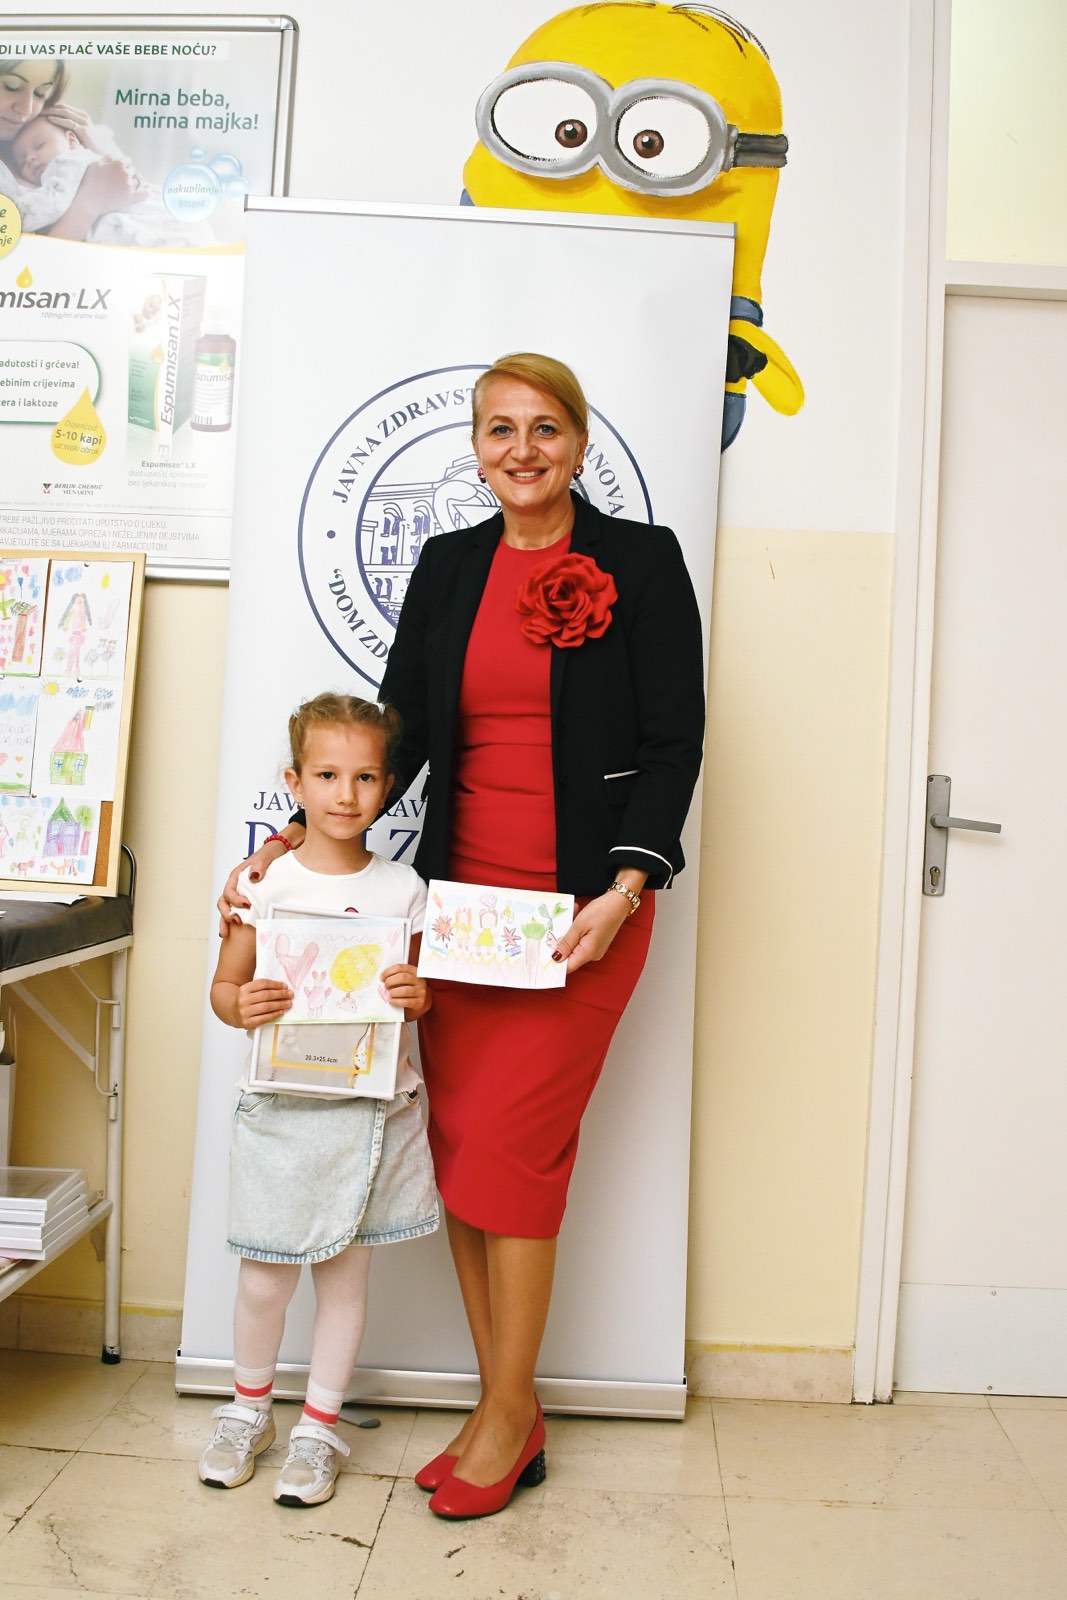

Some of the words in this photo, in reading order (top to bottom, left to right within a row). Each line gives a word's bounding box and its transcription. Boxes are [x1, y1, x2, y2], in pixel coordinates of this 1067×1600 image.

[15, 44, 27, 55] LI
[30, 44, 56, 55] VAS
[59, 41, 94, 55] PLAČ
[96, 41, 131, 55] VAŠE
[134, 44, 168, 56] BEBE
[172, 42, 217, 56] NOĆU?
[115, 89, 171, 106] Mirna
[178, 89, 230, 110] beba,
[134, 112, 189, 130] mirna
[195, 113, 259, 133] majka!
[76, 288, 113, 310] LX
[167, 293, 182, 323] LX
[40, 359, 44, 368] i
[45, 359, 80, 371] grčeva!
[160, 324, 180, 426] Espumisan
[0, 377, 31, 387] ebinim
[32, 379, 76, 390] crijevima
[18, 398, 22, 407] i
[23, 398, 59, 408] laktoze
[55, 429, 78, 441] 5-10
[80, 432, 103, 447] kapi
[128, 469, 162, 479] dostupan
[331, 433, 382, 504] JAVNA
[128, 479, 141, 487] bez
[22, 515, 56, 526] PAŽLJIVO
[95, 518, 133, 528] UPUTSTVO
[134, 520, 140, 528] O
[41, 528, 77, 537] MJERAMA
[78, 529, 107, 538] OPREZA
[112, 529, 158, 540] NEŽELJENIM
[158, 532, 200, 541] DEJSTVIMA
[40, 539, 50, 547] SE
[51, 539, 61, 548] SA
[62, 539, 100, 549] LJEKAROM
[358, 628, 389, 664] ZD
